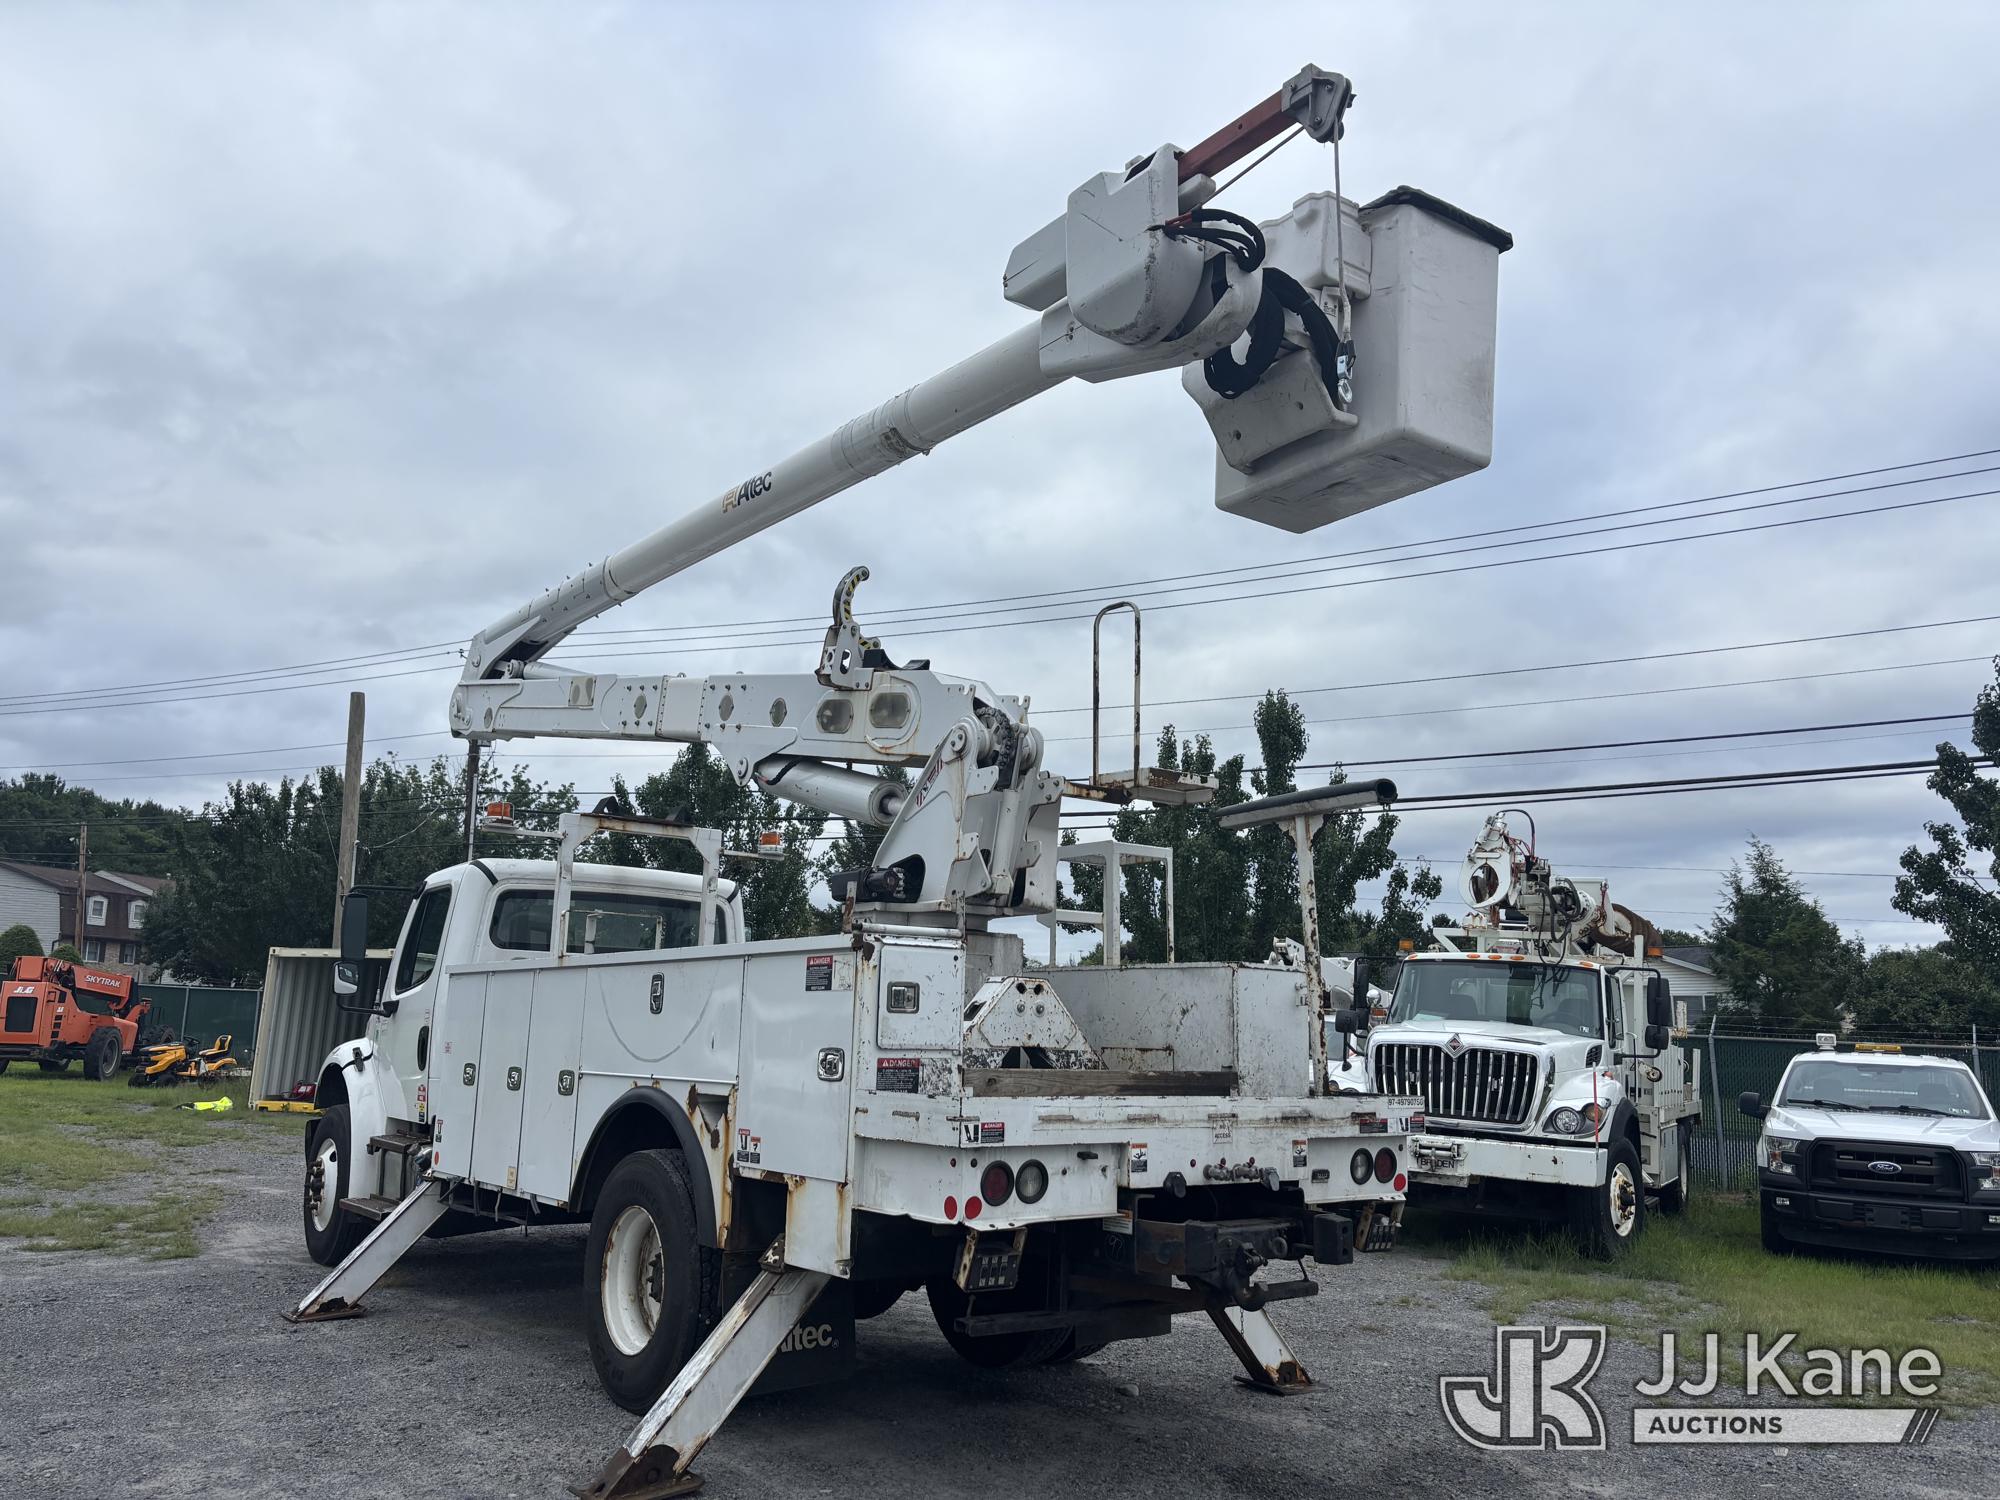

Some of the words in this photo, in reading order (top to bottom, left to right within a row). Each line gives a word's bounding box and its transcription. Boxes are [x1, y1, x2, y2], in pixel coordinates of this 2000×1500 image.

[86, 974, 121, 988] SKYTRAK
[13, 986, 35, 994] JLG
[1420, 1158, 1455, 1168] BRDEN
[780, 1323, 833, 1353] ltec
